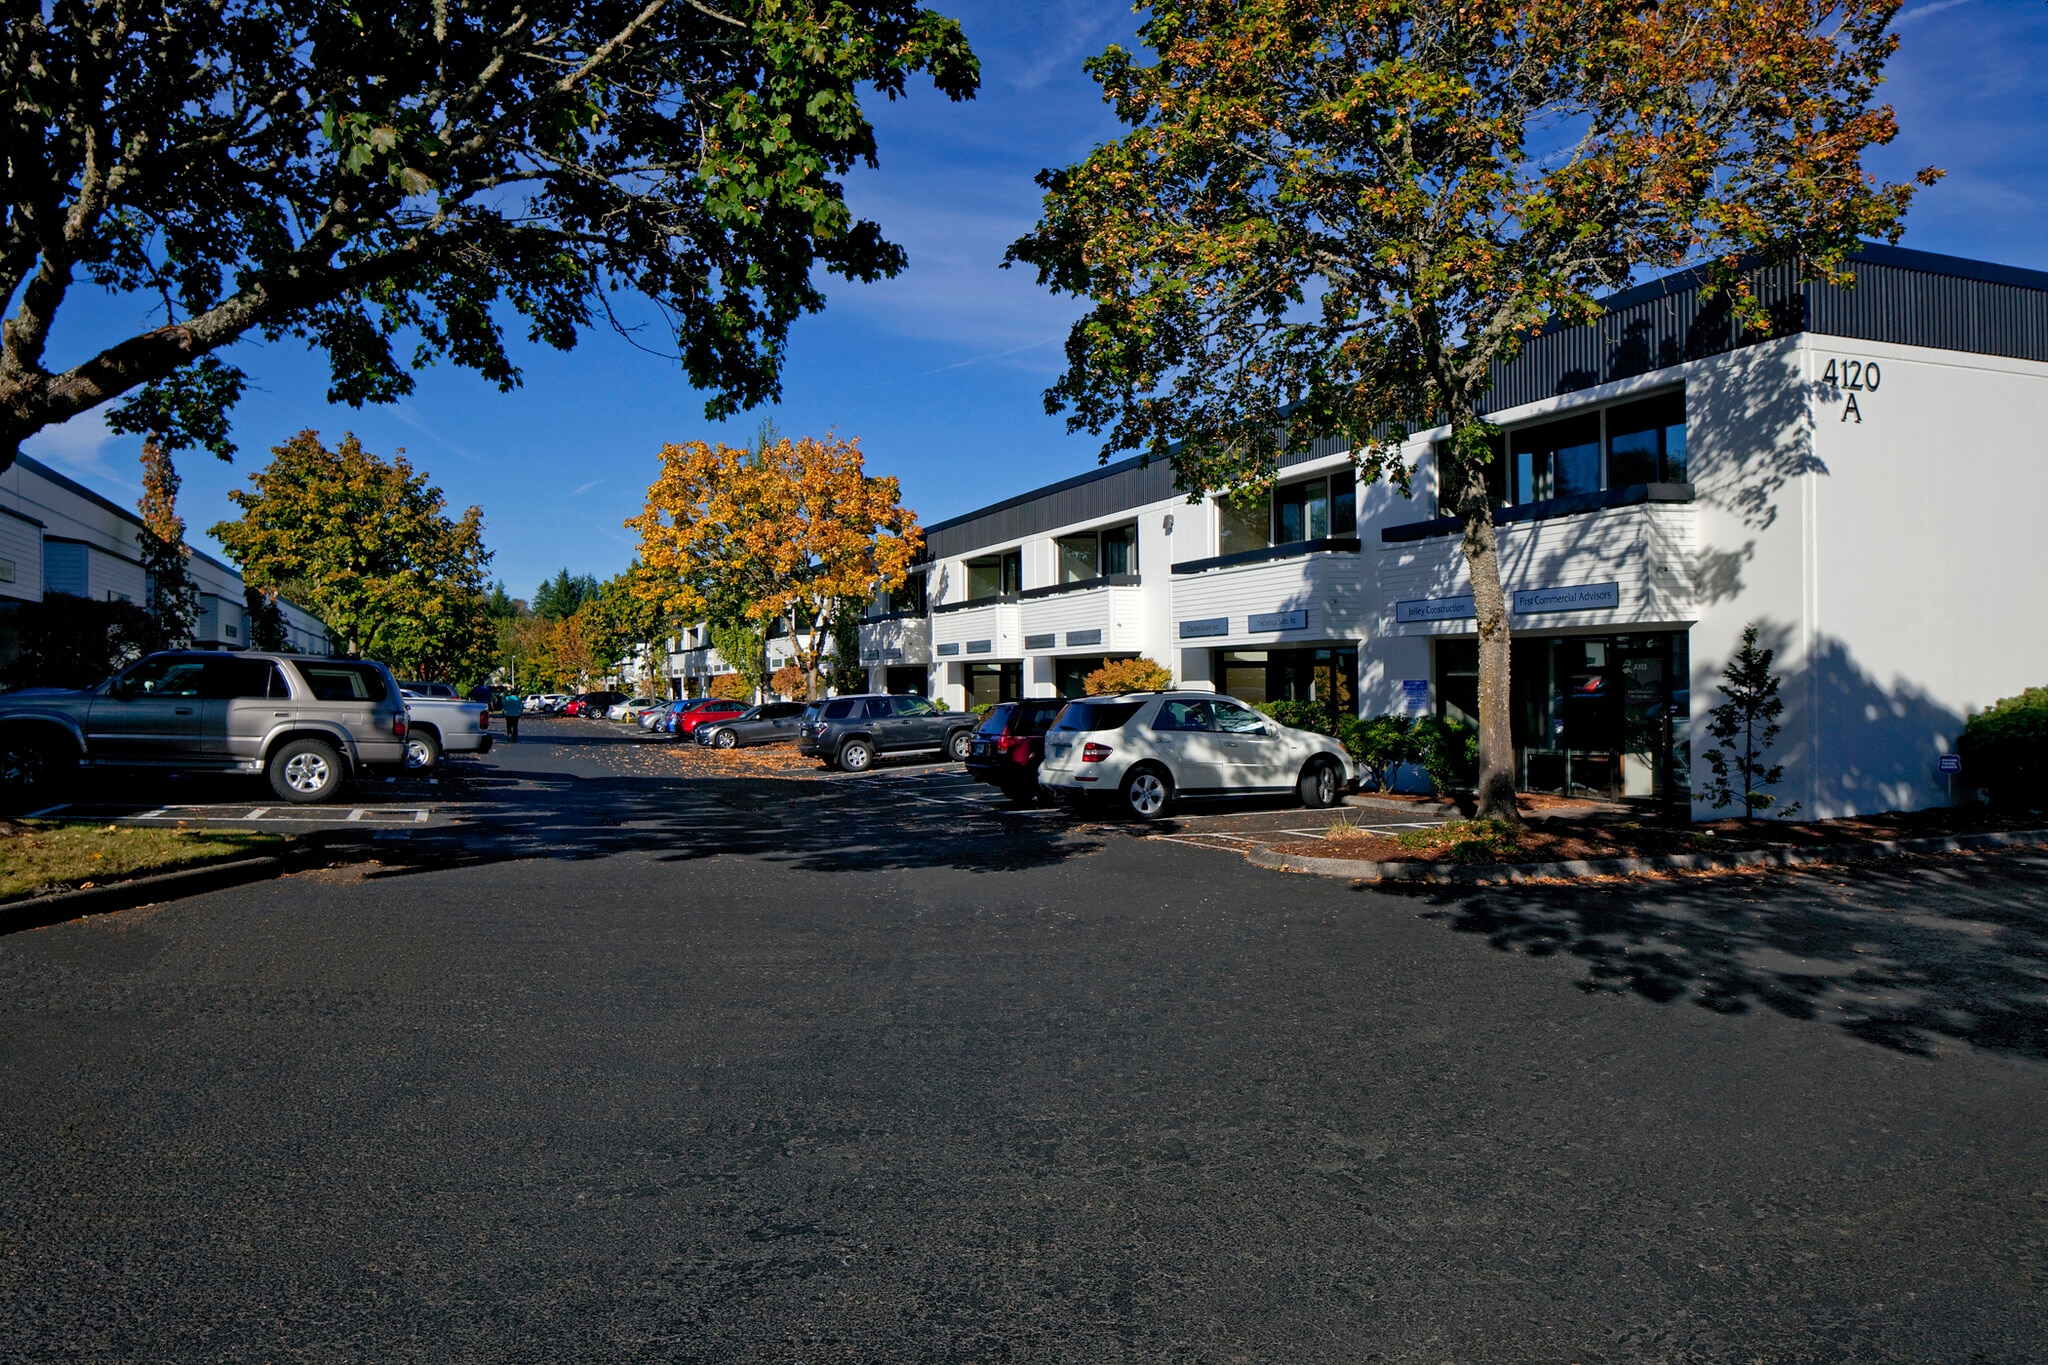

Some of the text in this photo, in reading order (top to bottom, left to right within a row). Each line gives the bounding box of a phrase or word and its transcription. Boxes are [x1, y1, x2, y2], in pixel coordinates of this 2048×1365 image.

[1821, 358, 1881, 392] 4120
[1841, 392, 1862, 424] A
[1519, 591, 1612, 606] First Commercial Advisors
[1408, 603, 1466, 617] Jolley Construction
[1633, 663, 1648, 671] A113
